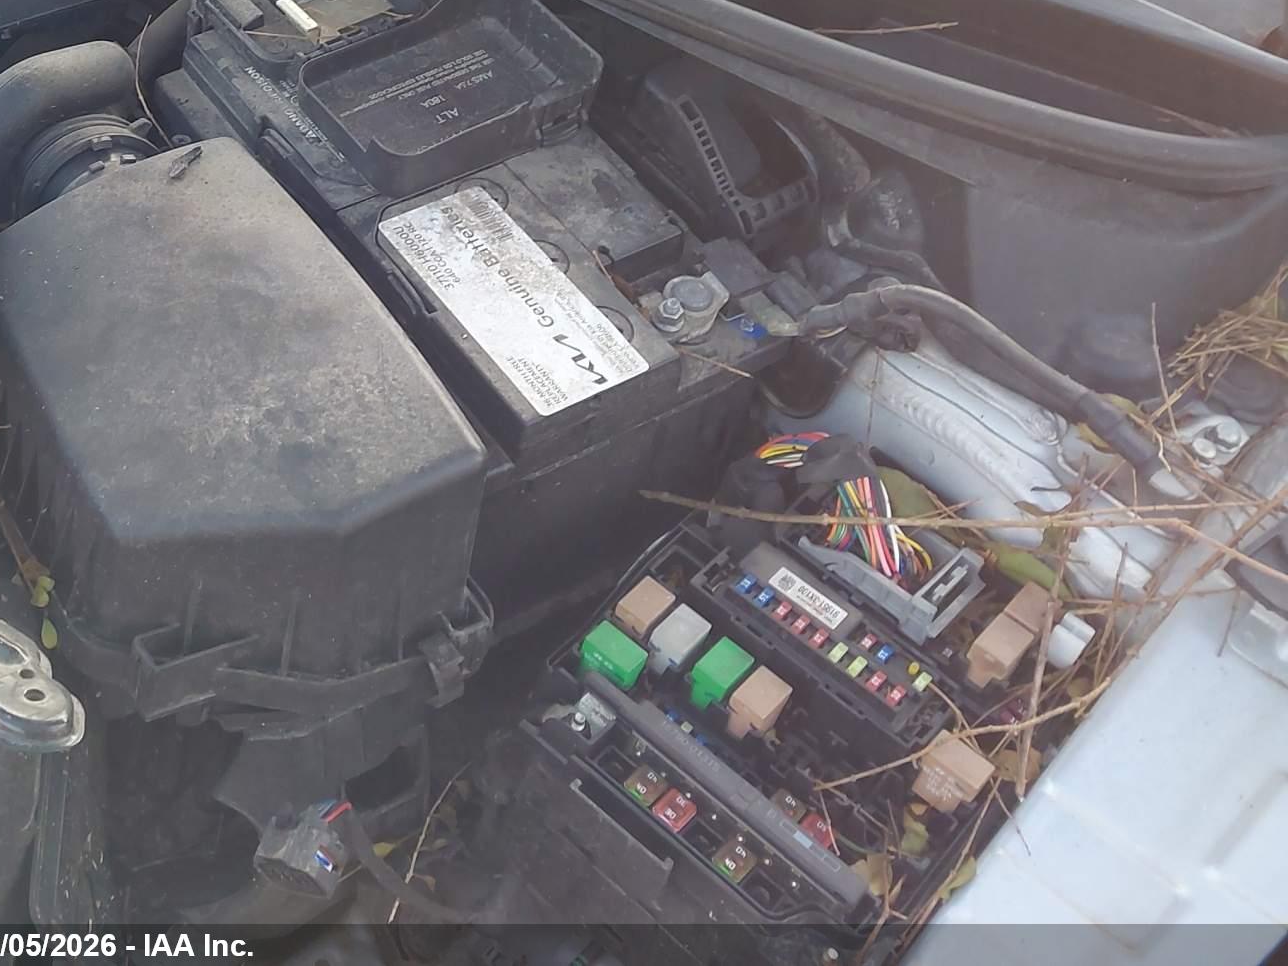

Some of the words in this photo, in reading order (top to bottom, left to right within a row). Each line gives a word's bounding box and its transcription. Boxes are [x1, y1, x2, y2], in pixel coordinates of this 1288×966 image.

[435, 106, 462, 125] ALT
[436, 204, 501, 268] Batteries
[493, 266, 556, 329] Genuine
